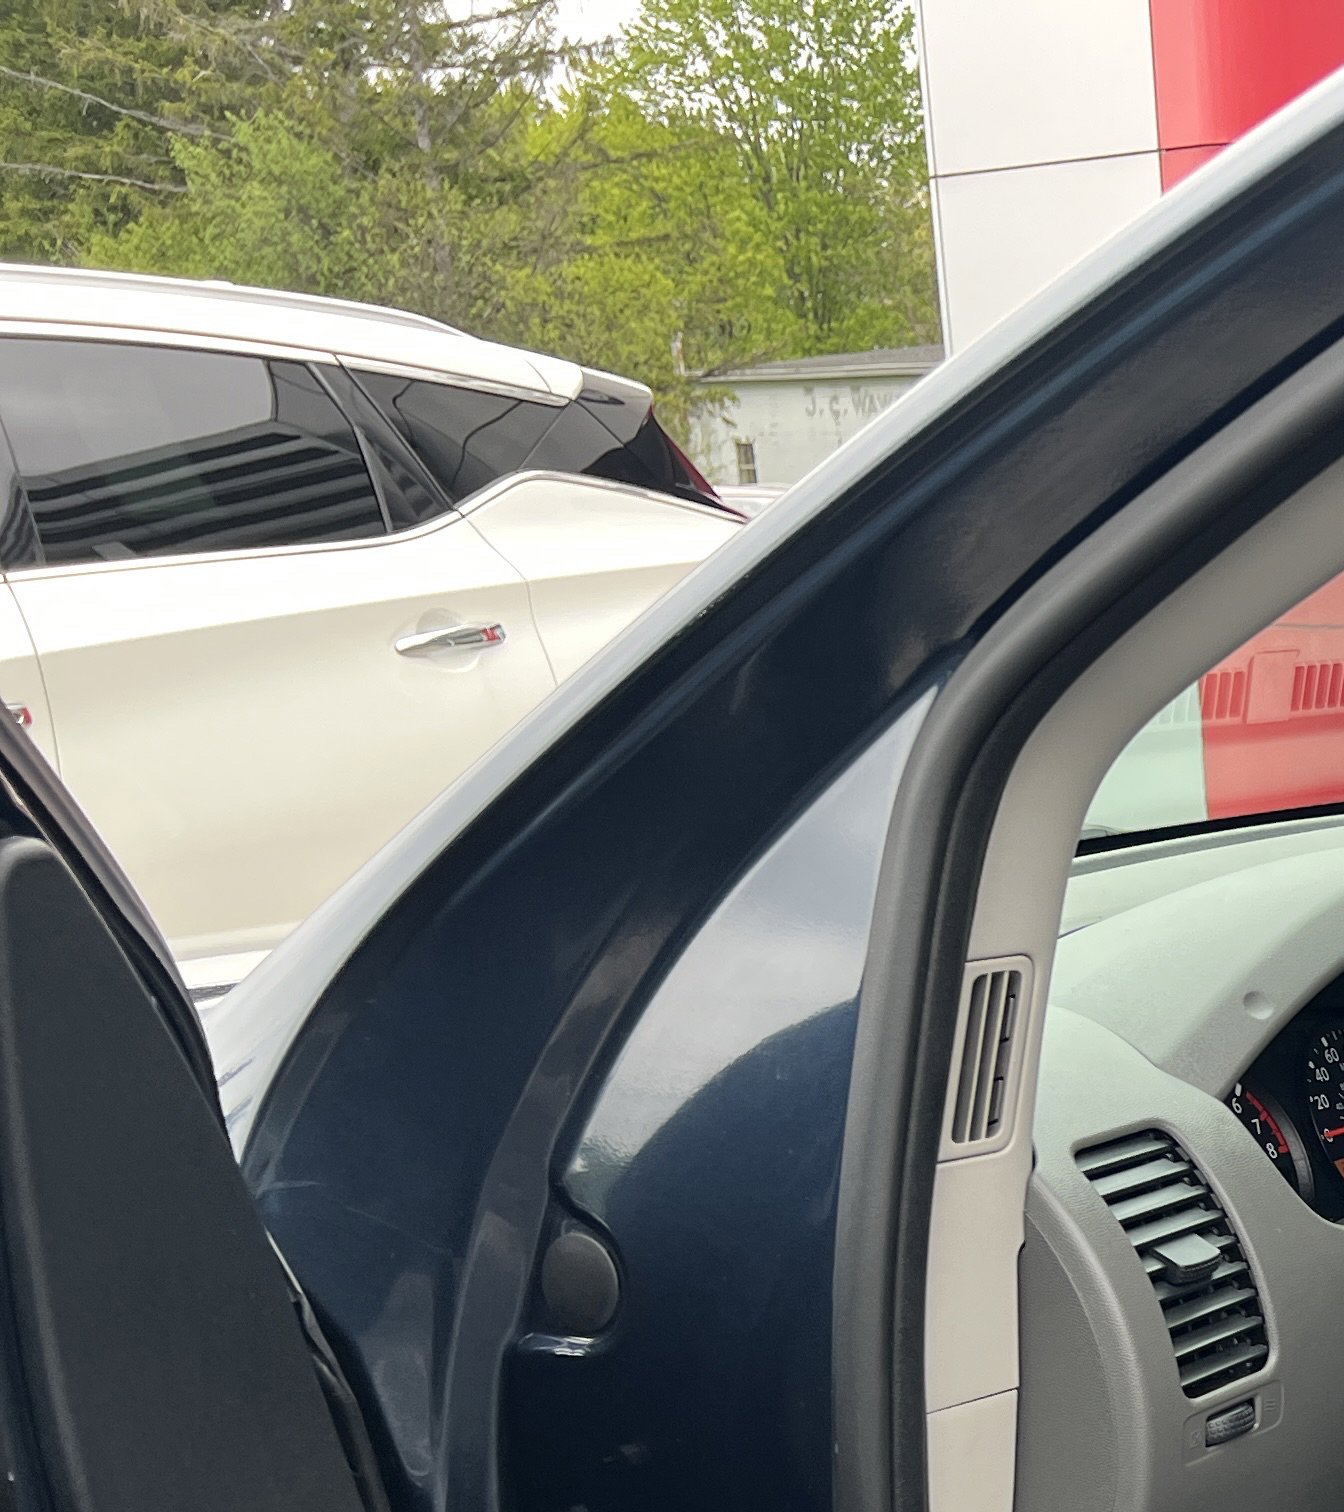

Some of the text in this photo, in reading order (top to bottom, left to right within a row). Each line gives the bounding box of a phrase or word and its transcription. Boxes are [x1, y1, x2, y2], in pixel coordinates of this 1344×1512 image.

[1324, 1047, 1340, 1063] 60
[1315, 1067, 1330, 1082] 40
[1231, 1097, 1243, 1114] 6
[1313, 1094, 1330, 1110] 20
[1251, 1118, 1261, 1135] 7
[1266, 1142, 1278, 1159] 8
